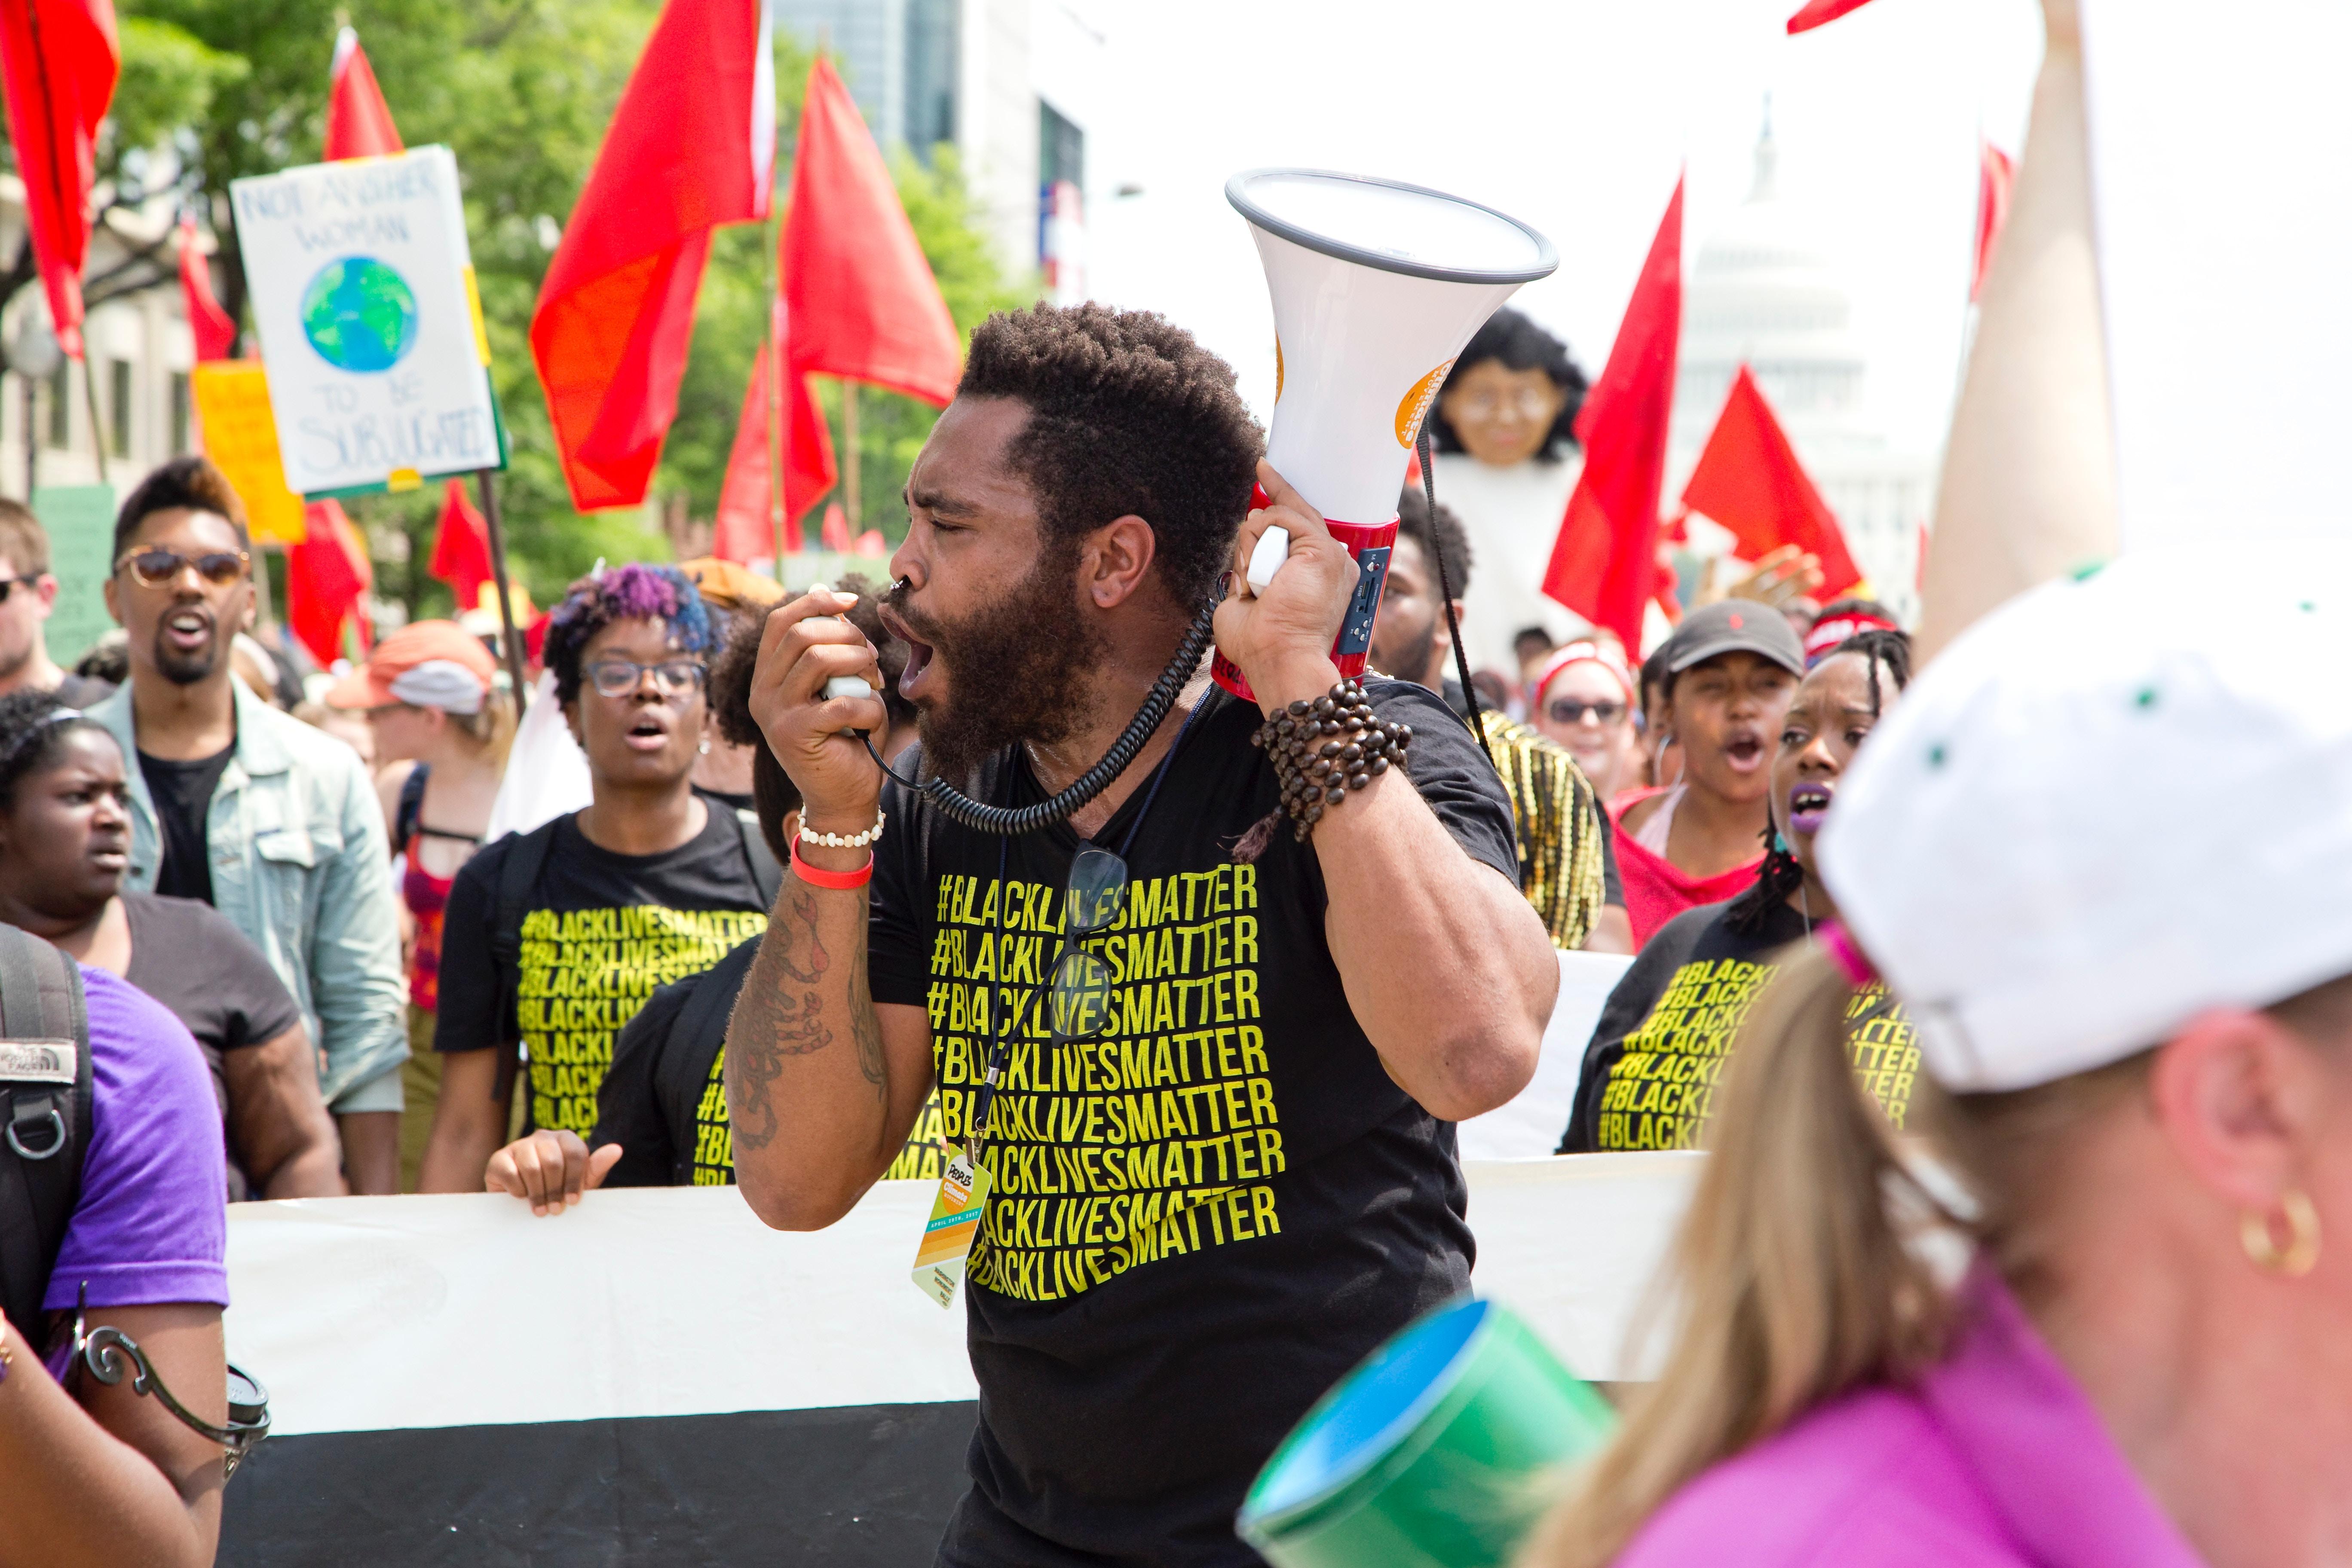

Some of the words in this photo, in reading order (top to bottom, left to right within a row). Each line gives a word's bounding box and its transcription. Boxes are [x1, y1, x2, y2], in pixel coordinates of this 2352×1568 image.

[241, 180, 303, 222] NOT
[319, 158, 441, 207] ANOTHER
[294, 211, 411, 253] WOMAN
[310, 381, 360, 413] TO
[386, 371, 425, 407] BE
[1401, 370, 1440, 436] MOVEMENT
[943, 1181, 968, 1203] Climate
[948, 1164, 972, 1187] PEOPLES
